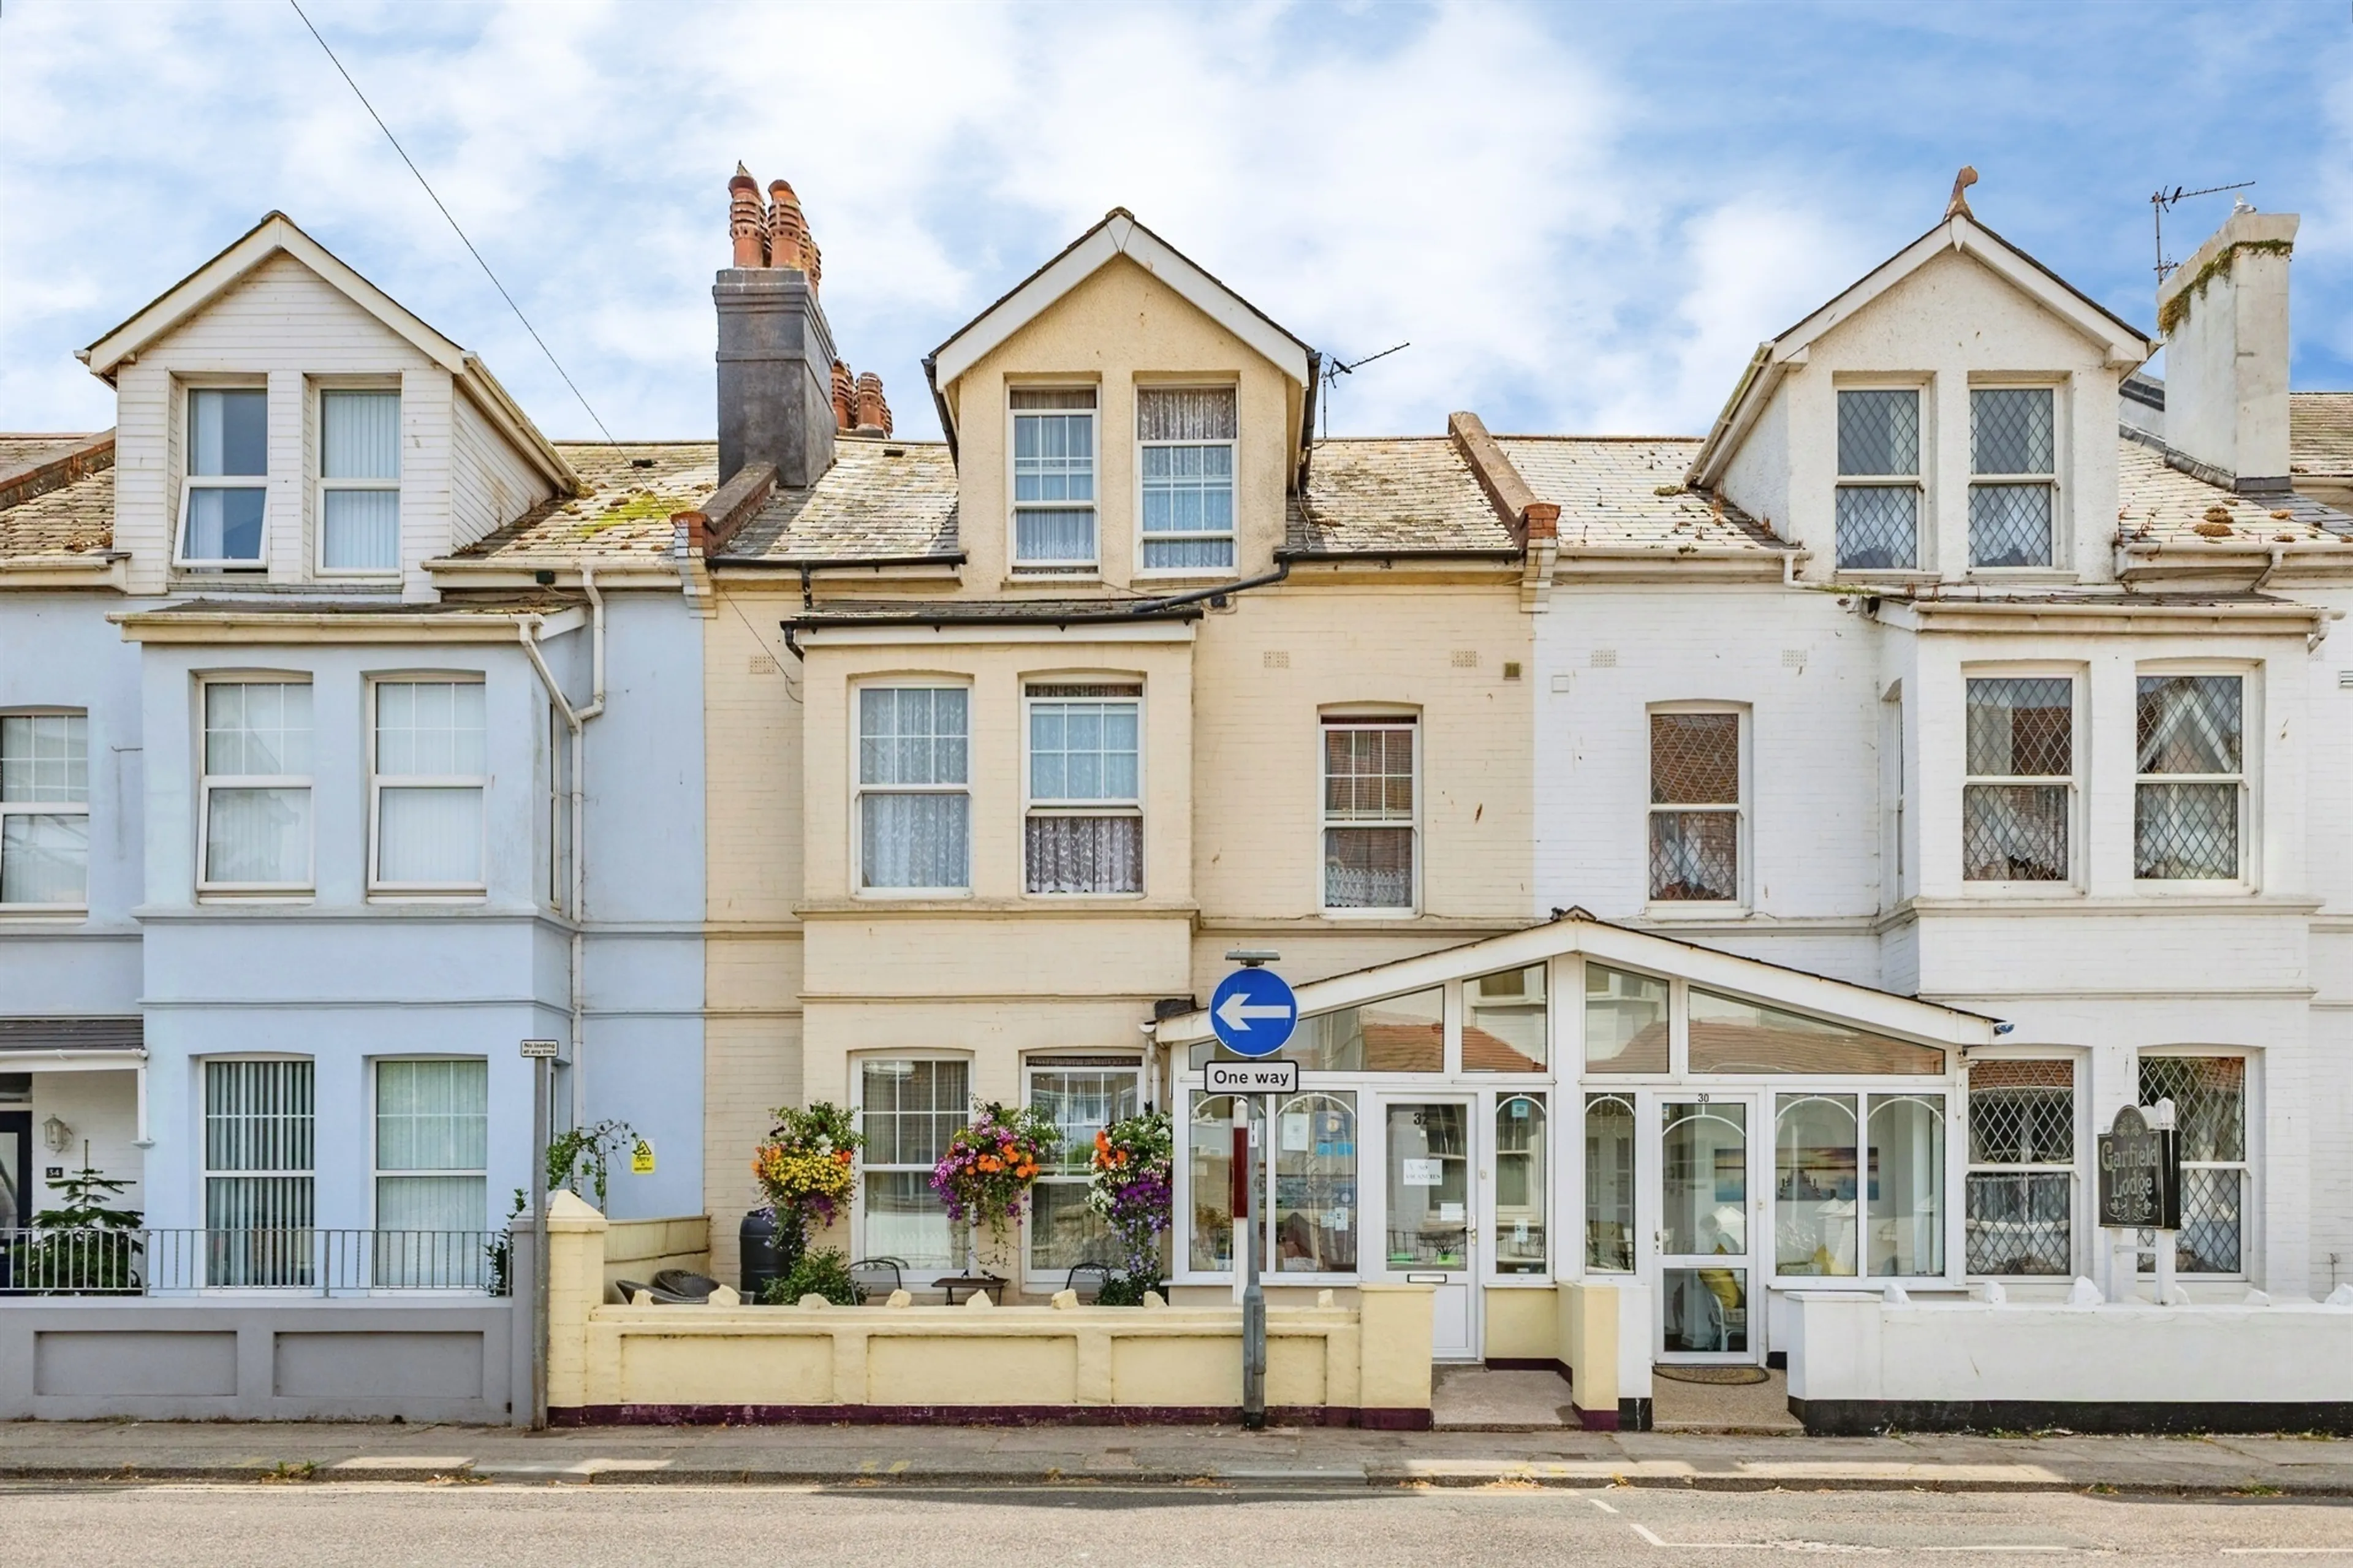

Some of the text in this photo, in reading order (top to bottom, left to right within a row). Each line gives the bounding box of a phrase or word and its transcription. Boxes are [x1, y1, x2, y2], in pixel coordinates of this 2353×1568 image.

[1214, 1069, 1289, 1086] One way
[1698, 1093, 1709, 1102] 30
[1413, 1112, 1429, 1126] 32
[2101, 1139, 2158, 1172] Garfield
[2112, 1168, 2153, 1201] Lodge
